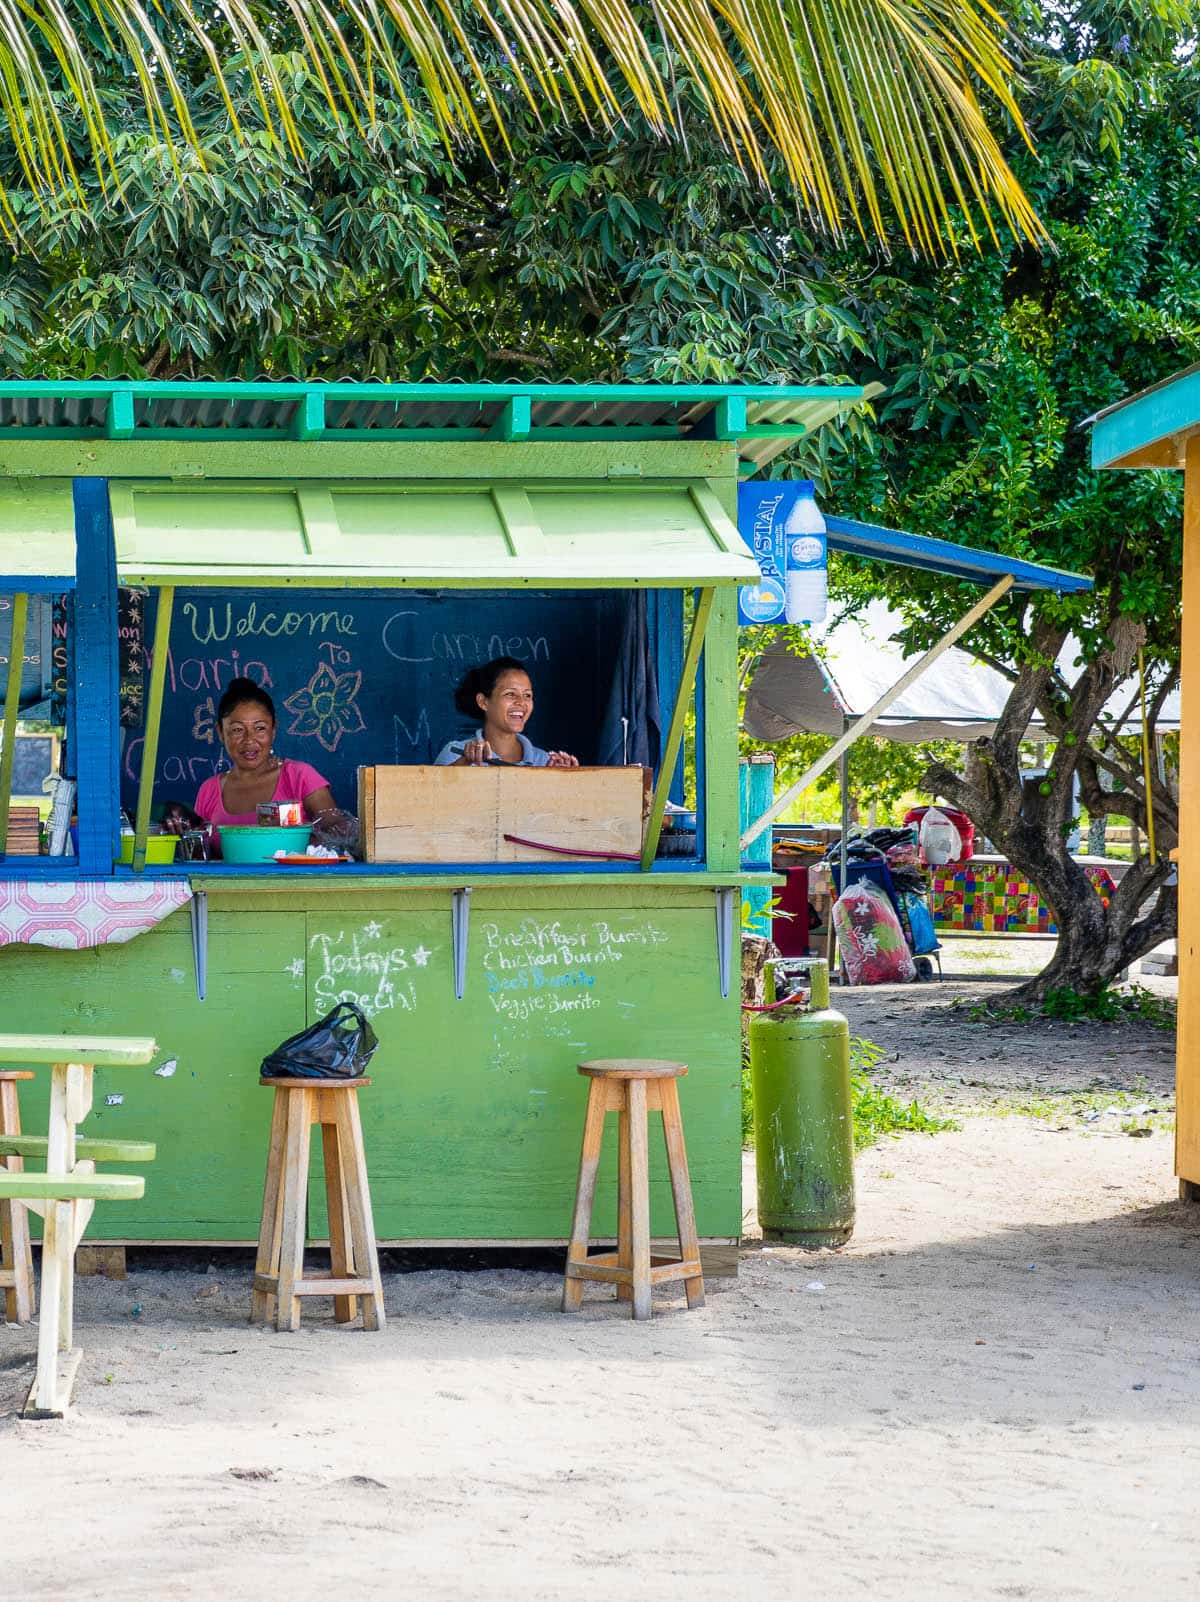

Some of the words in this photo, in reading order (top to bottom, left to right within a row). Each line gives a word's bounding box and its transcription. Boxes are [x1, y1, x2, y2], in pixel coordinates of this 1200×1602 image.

[754, 494, 781, 577] RYSTAL
[183, 601, 358, 645] Welcome
[318, 641, 351, 665] To
[483, 949, 560, 970] Chicken
[558, 945, 624, 966] Burrito
[489, 992, 546, 1019] Veggie
